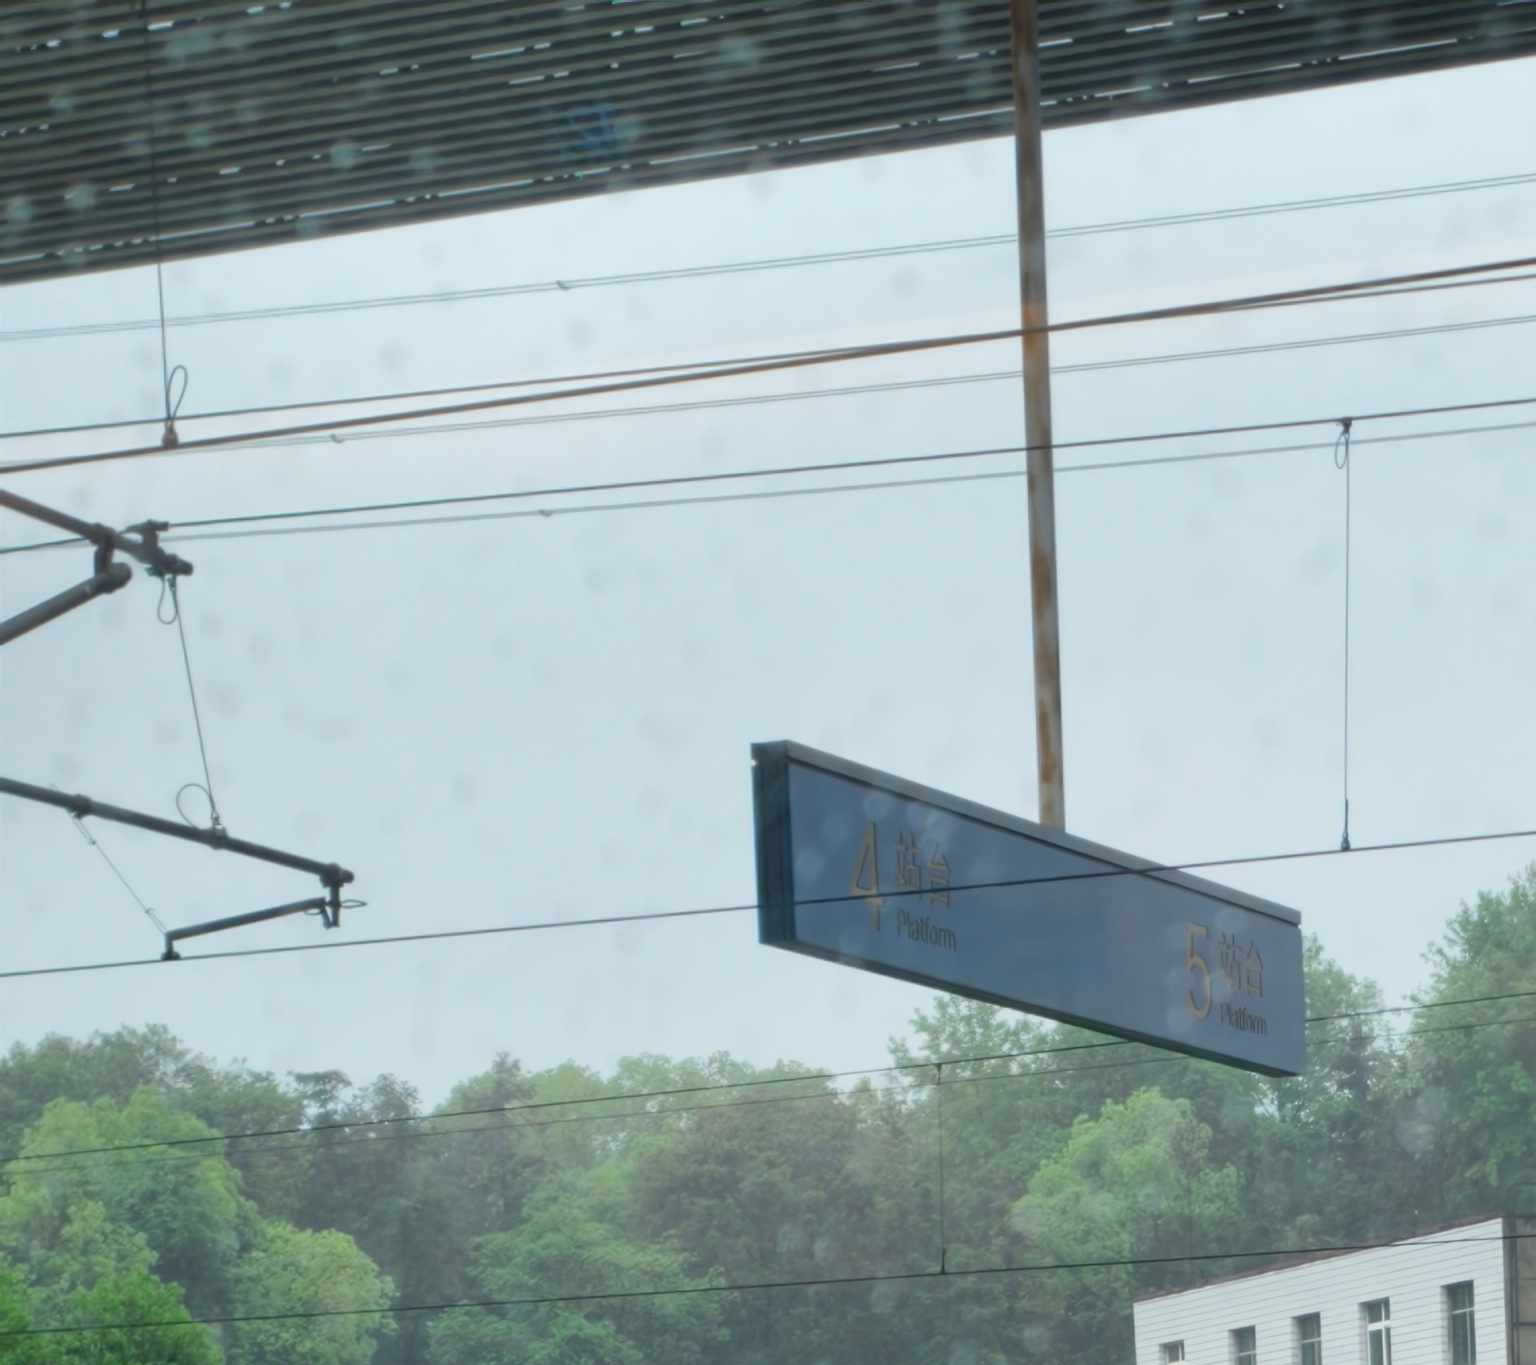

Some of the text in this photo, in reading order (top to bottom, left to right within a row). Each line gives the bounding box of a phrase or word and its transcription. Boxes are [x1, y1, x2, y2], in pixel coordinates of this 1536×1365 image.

[849, 820, 952, 932] 4 站台
[896, 908, 957, 952] Platform
[1184, 920, 1264, 1021] 5 站台
[1220, 1002, 1268, 1037] Platform
